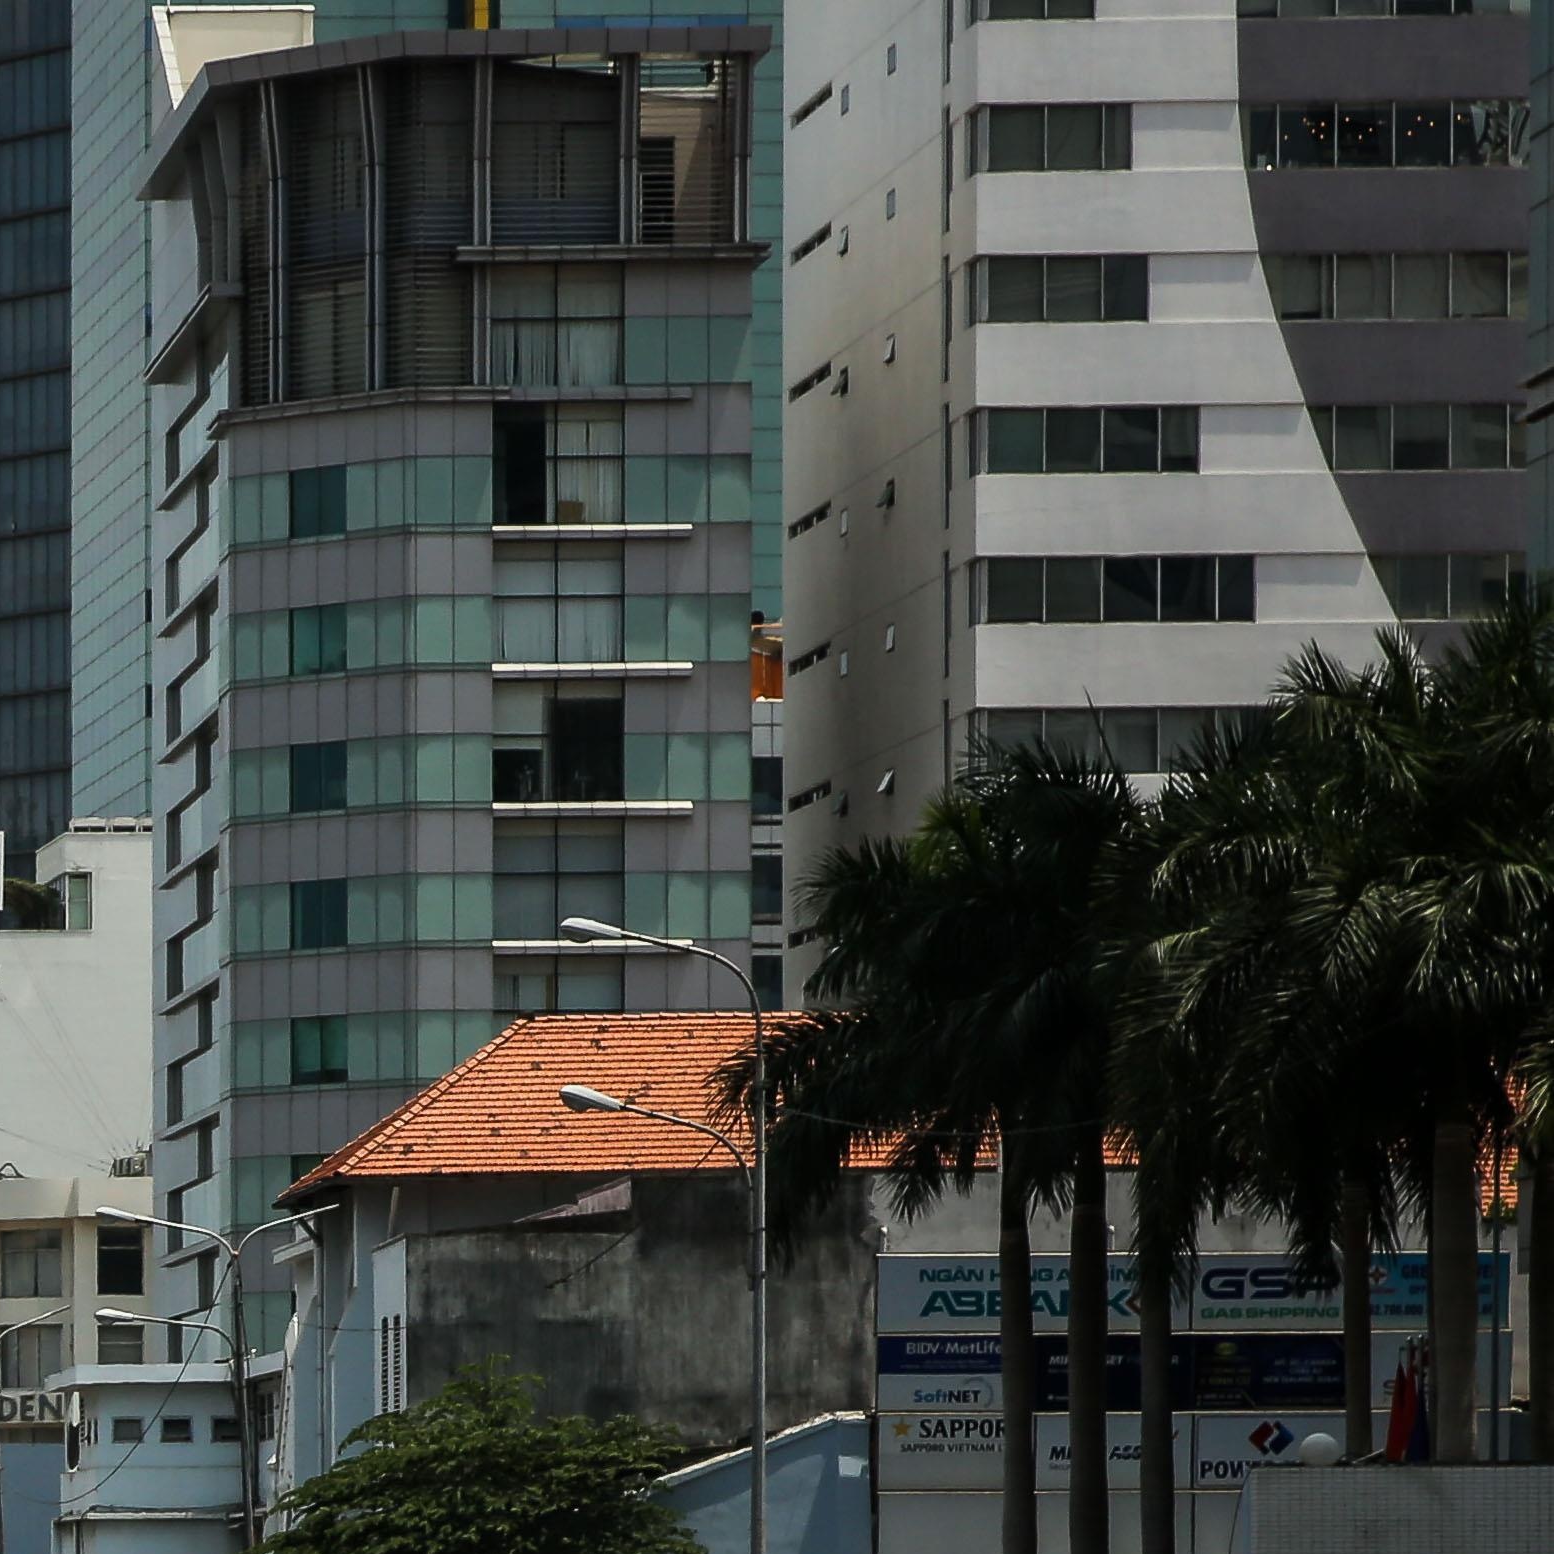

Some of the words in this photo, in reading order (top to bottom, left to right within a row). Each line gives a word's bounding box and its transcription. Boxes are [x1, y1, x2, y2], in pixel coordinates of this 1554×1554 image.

[1200, 1306, 1243, 1320] GAS
[1245, 1306, 1341, 1319] SHIPPING
[918, 1418, 1005, 1439] SAPPOR
